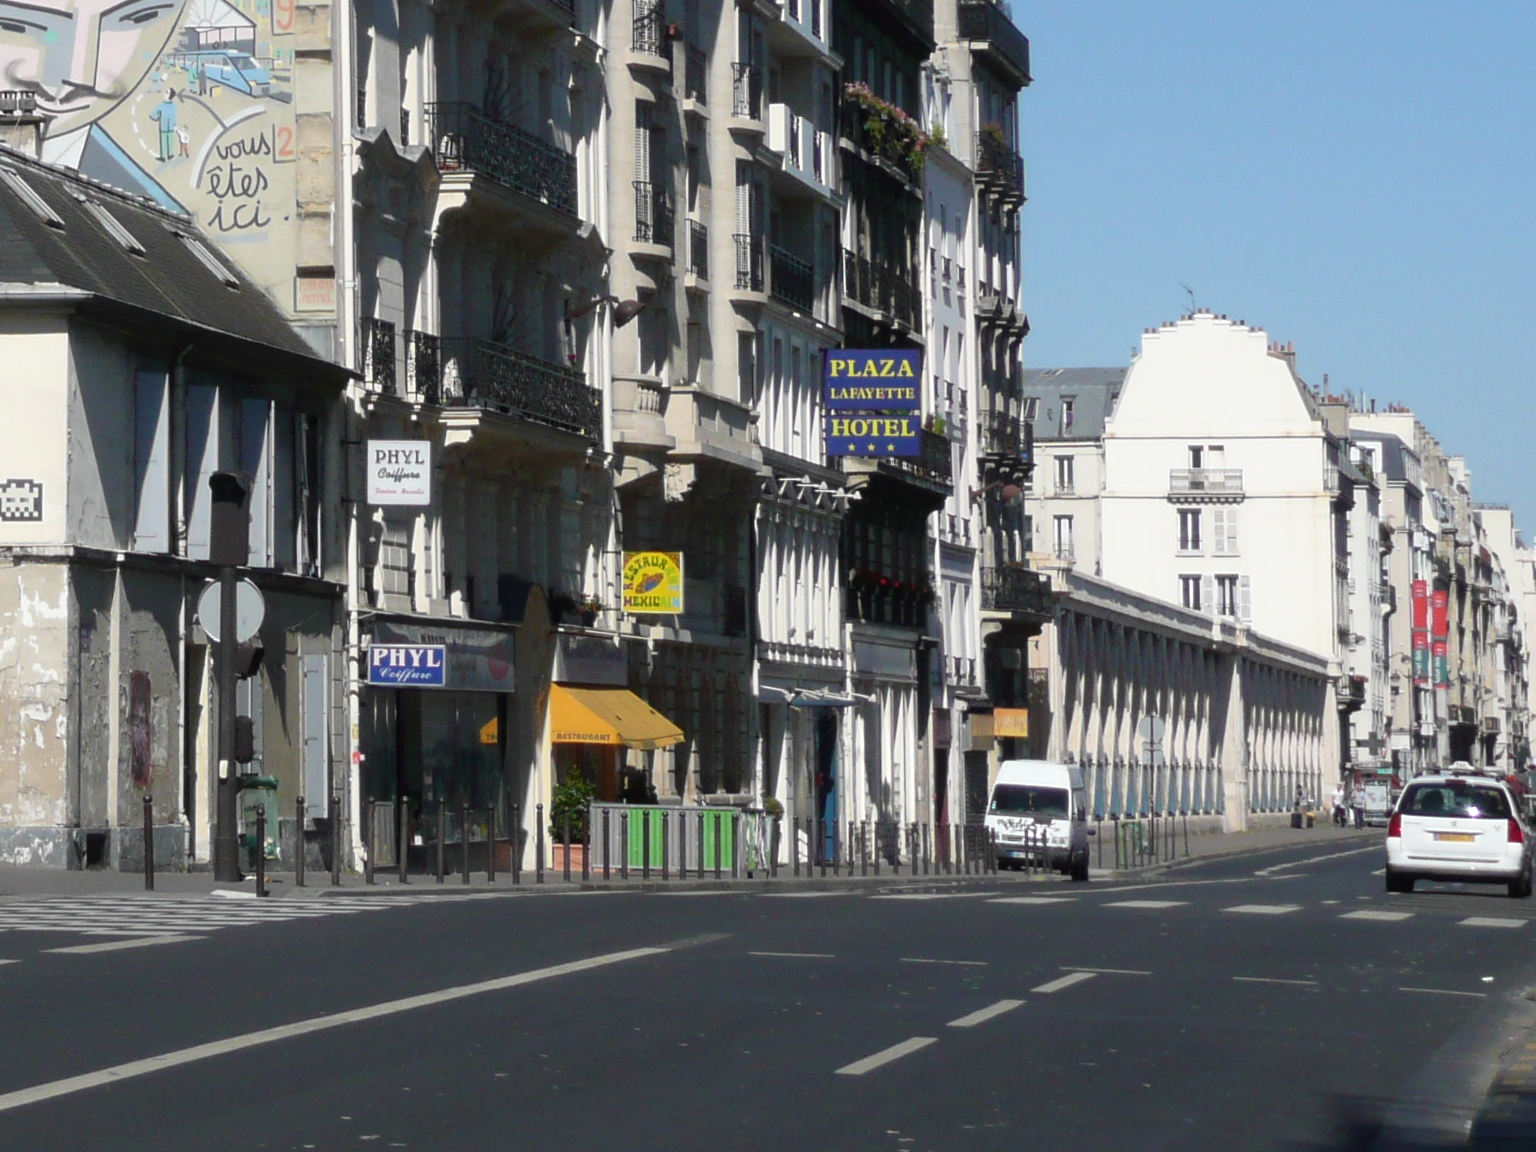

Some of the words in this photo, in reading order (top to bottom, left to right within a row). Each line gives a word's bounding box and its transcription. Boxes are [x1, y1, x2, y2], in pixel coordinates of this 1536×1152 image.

[216, 131, 271, 160] vous
[206, 162, 268, 198] êtes
[207, 199, 271, 232] ici
[830, 359, 914, 377] PLAZA
[830, 388, 915, 400] LAFAYETTE
[831, 419, 915, 437] HOTEL
[375, 449, 425, 465] PHYL
[378, 467, 421, 483] Coiffure
[372, 648, 441, 667] PHYL
[379, 667, 432, 682] Coiffure
